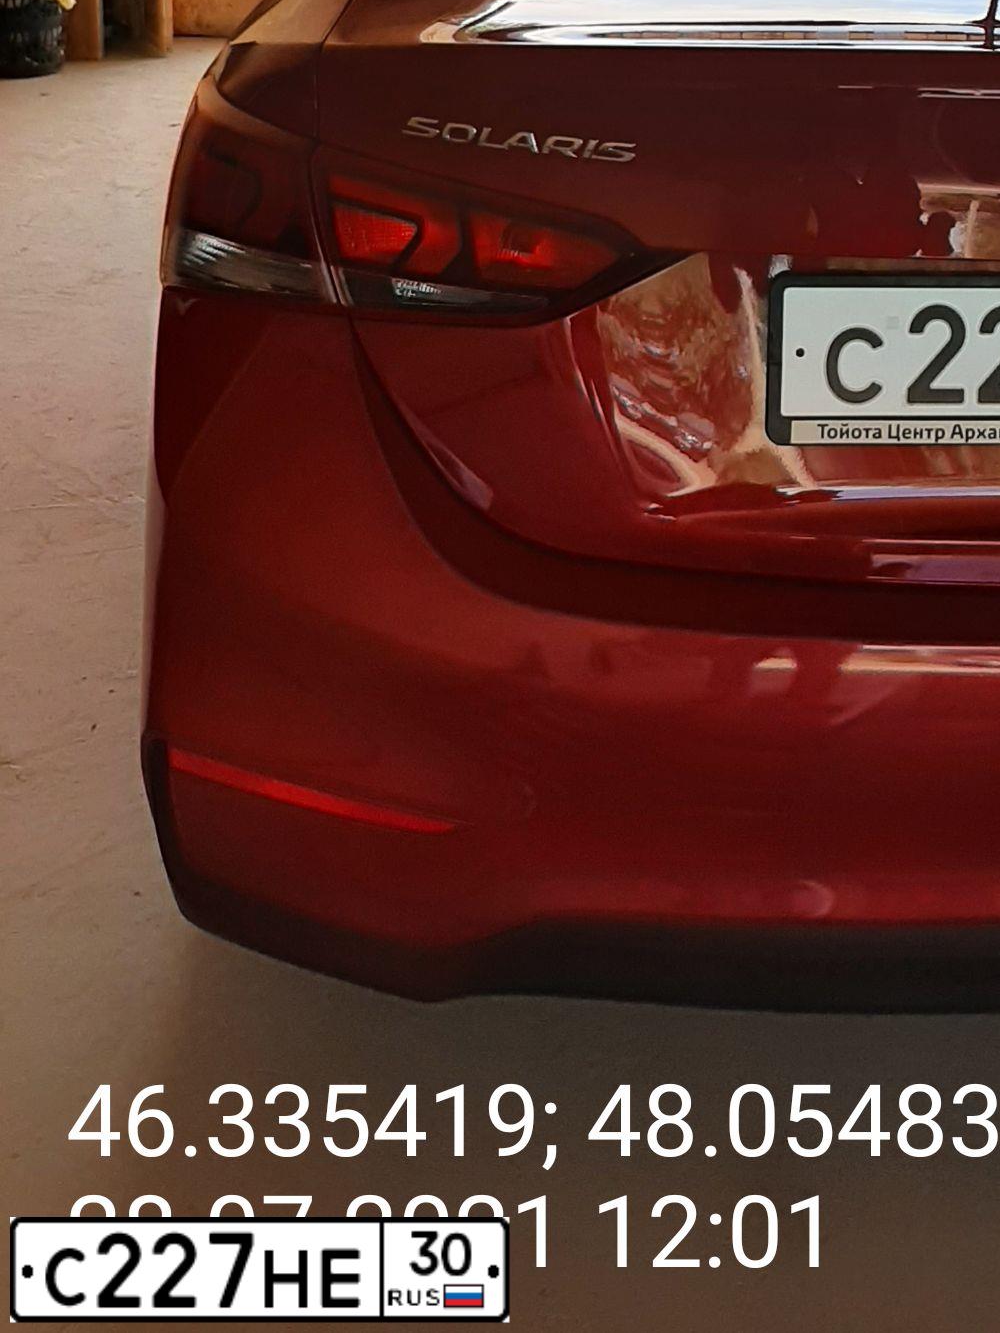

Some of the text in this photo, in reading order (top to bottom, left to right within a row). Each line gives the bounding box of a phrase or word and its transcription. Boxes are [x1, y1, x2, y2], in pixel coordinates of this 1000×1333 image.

[402, 116, 637, 163] SOLARIS
[817, 423, 883, 440] Тойота
[887, 424, 945, 444] Центр
